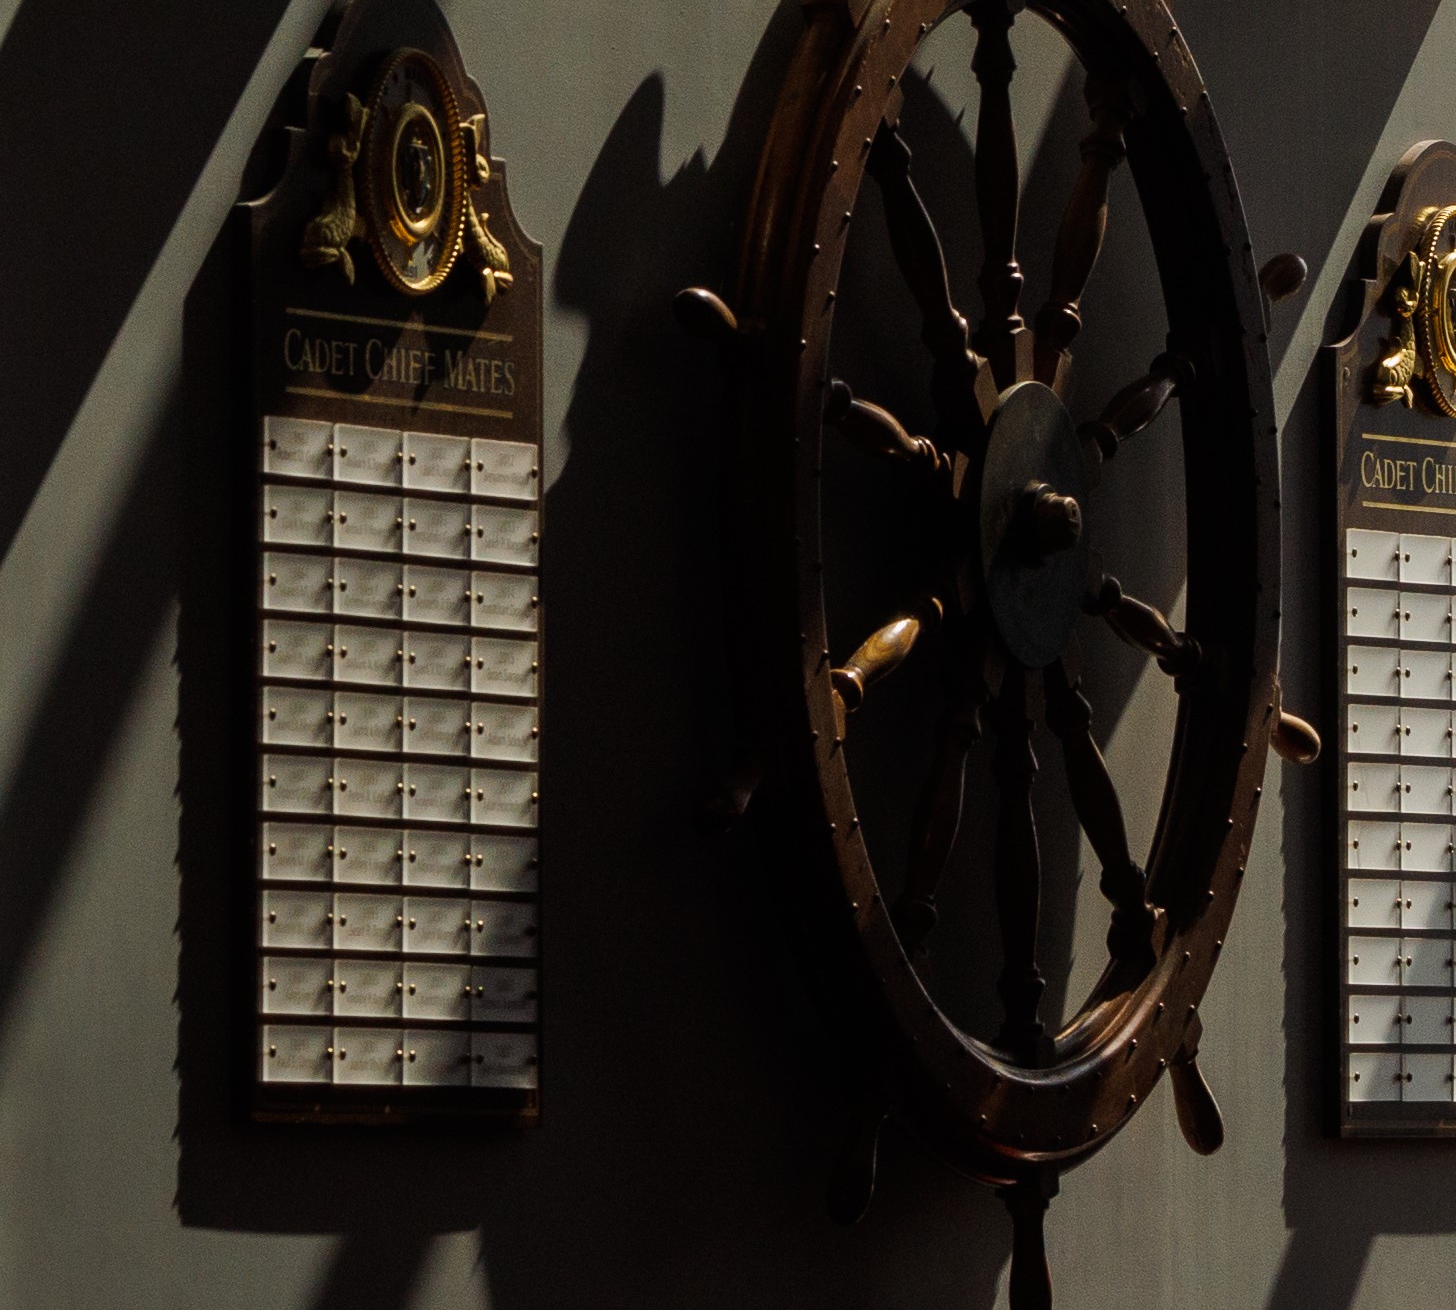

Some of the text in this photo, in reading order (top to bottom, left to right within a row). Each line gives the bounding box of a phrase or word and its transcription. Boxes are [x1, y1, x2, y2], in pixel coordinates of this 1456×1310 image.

[284, 328, 516, 397] CADET CHIEF MATES
[1361, 451, 1418, 493] CADET
